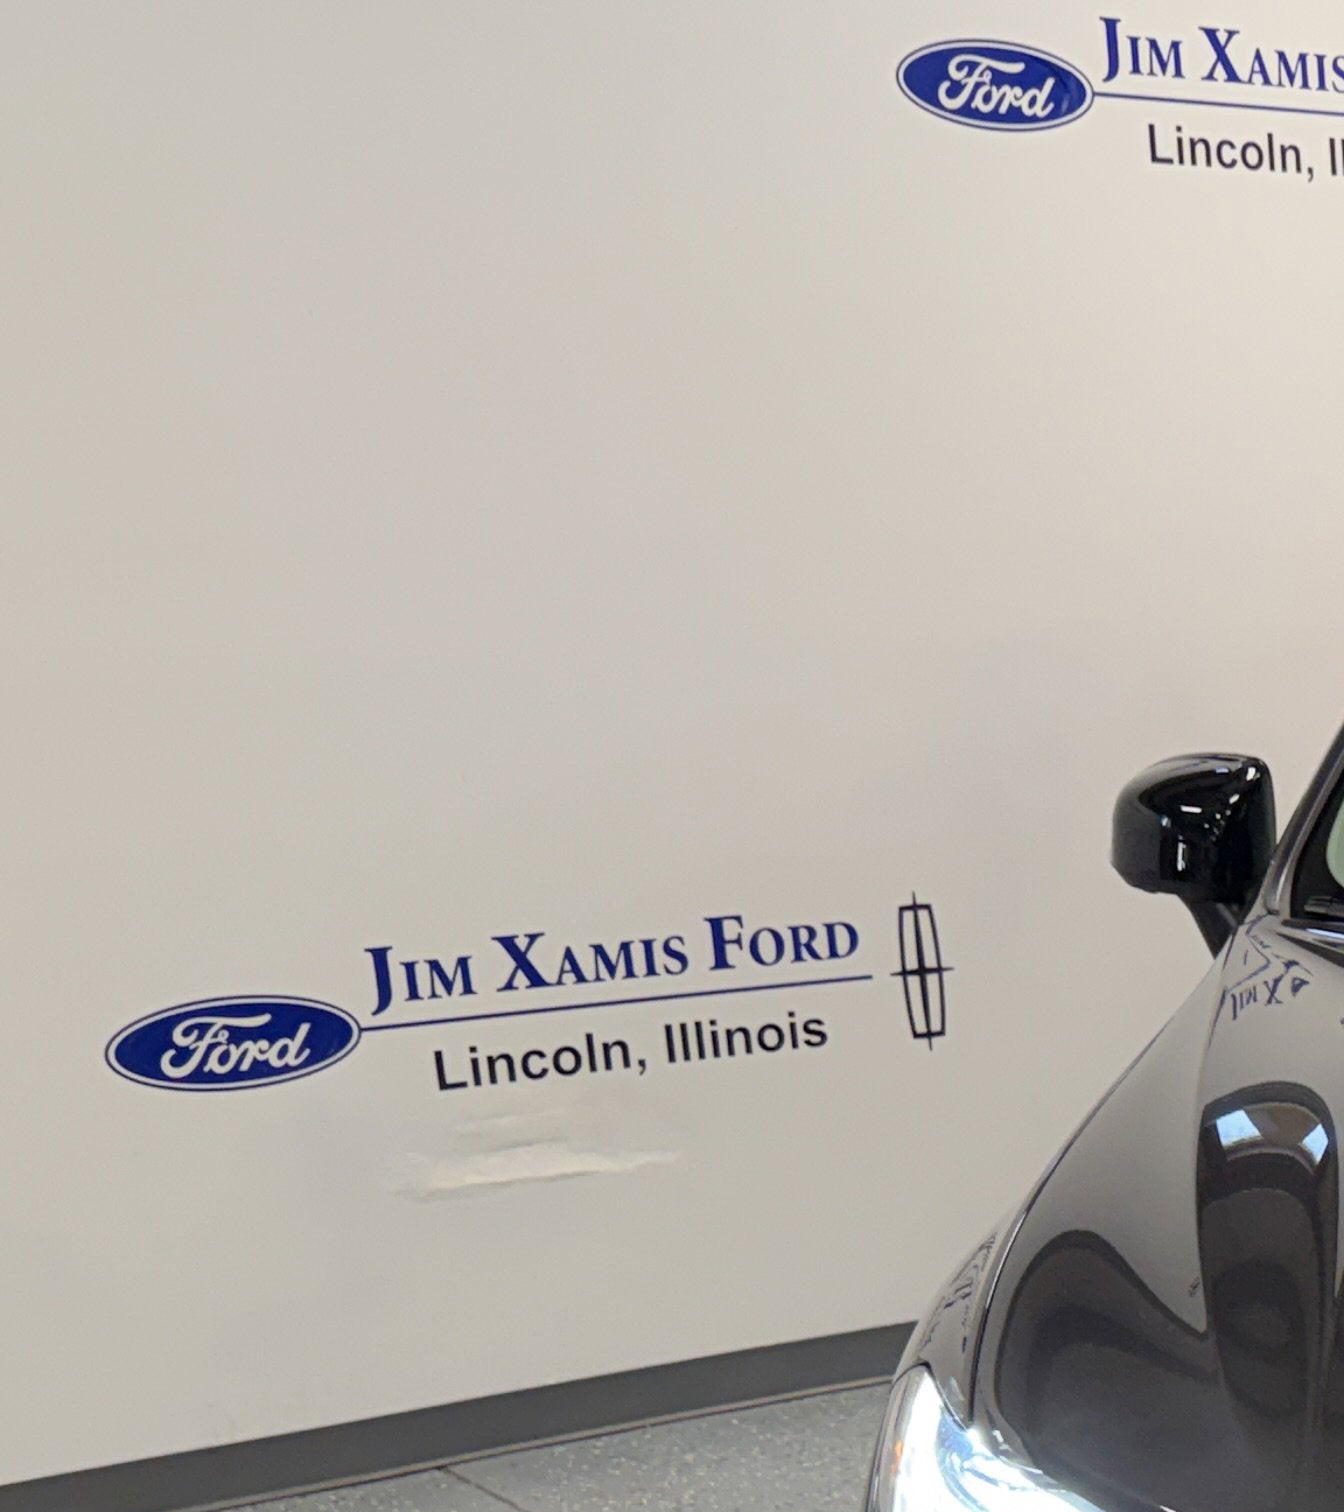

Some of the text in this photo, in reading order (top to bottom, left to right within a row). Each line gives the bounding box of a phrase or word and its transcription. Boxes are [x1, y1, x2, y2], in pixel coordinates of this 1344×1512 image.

[1098, 16, 1185, 84] JIM
[936, 53, 1055, 119] Ford
[1147, 124, 1315, 183] Lincoln,
[363, 914, 861, 1017] JIM XAMIS FORD
[159, 1012, 312, 1080] Ford
[432, 1010, 830, 1092] Lincoln, Illinois
